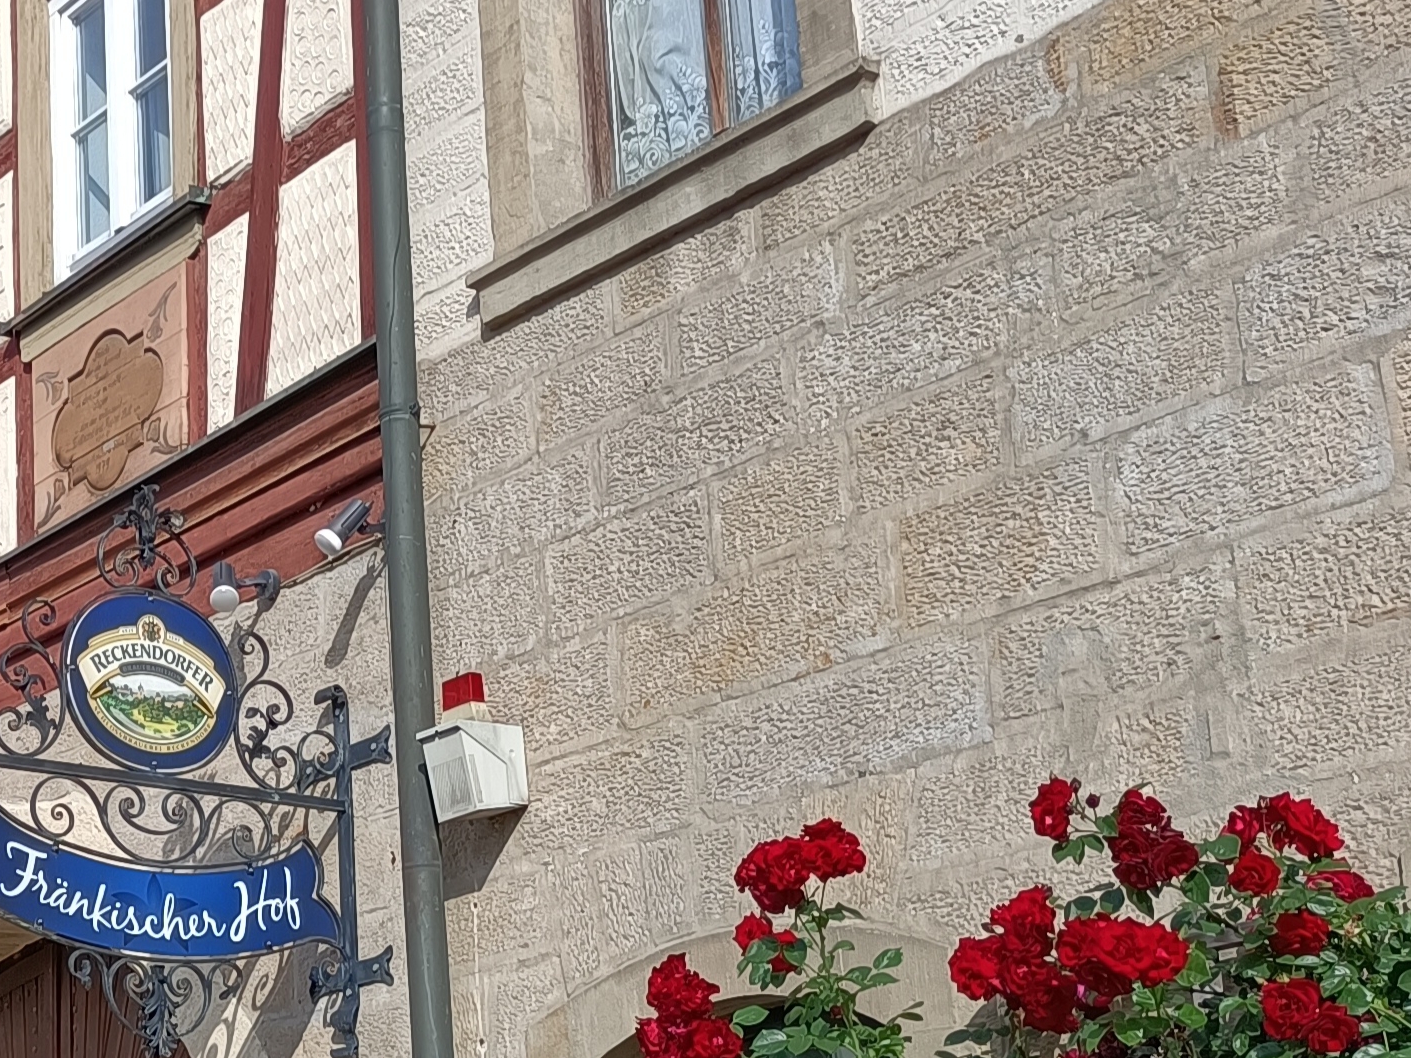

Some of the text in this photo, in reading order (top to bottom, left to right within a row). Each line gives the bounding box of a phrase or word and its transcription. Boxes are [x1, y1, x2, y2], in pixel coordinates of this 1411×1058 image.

[89, 643, 214, 693] RECKENDORFER
[0, 842, 300, 942] Fränkischer Hof
